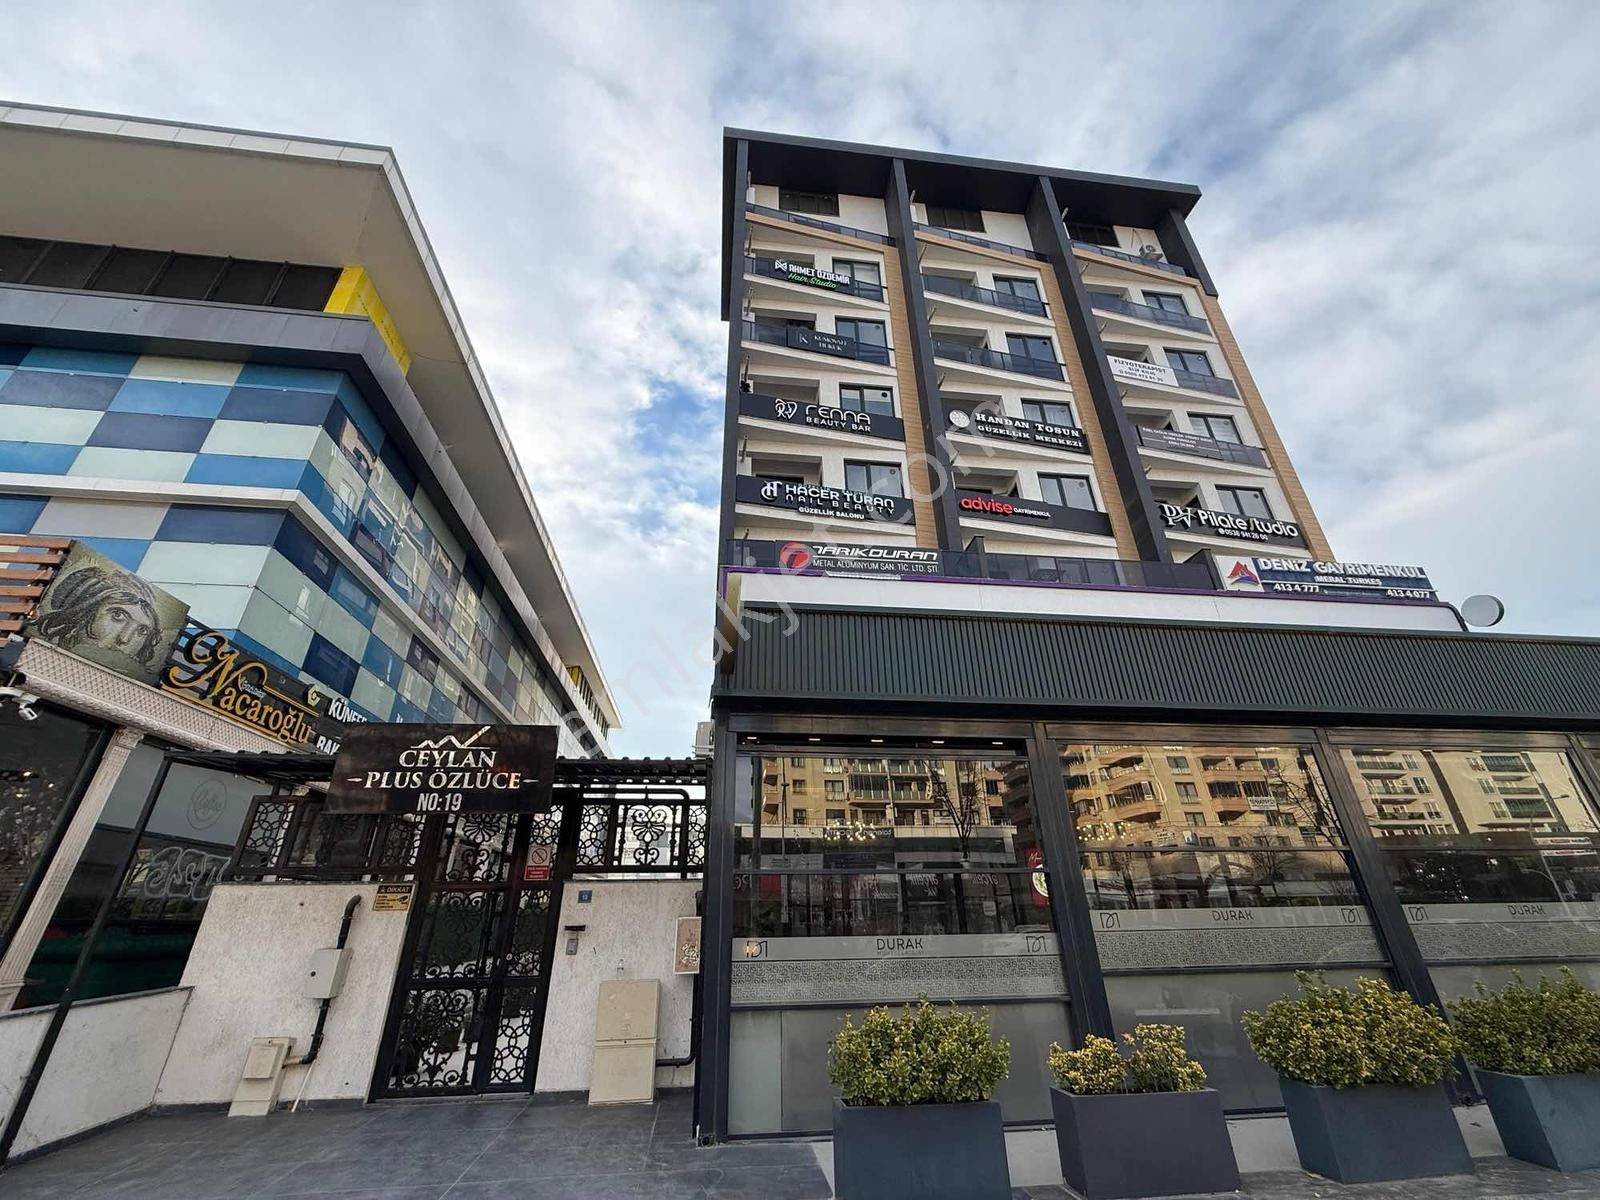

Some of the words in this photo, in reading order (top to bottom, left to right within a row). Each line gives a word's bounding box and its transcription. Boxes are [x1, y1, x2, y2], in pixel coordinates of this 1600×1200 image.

[788, 264, 816, 277] AHMET
[809, 277, 837, 289] Studio
[806, 416, 847, 428] BEAUTY
[852, 423, 871, 433] BAR
[975, 412, 1030, 429] HANDAN
[1034, 423, 1081, 438] TOSUN
[785, 483, 840, 501] HACER
[785, 494, 824, 506] NAIL
[832, 500, 895, 515] BEAUTY
[798, 506, 835, 517] GÜZELLİK
[836, 511, 865, 520] SALONU
[960, 496, 1013, 515] advise
[812, 559, 835, 568] METAL
[1258, 557, 1311, 573] DENİZ
[1312, 561, 1427, 579] GAYRİMENKUL
[1313, 575, 1346, 584] MERAL
[168, 631, 313, 744] Nacaroğlu
[399, 750, 497, 769] CEYLAN
[363, 771, 423, 790] PLUS
[429, 767, 522, 790] ÖZLÜCE
[416, 792, 463, 812] NO:19
[1212, 909, 1255, 923] DURAK
[1508, 904, 1545, 917] DURAK
[876, 938, 924, 951] DURAK
